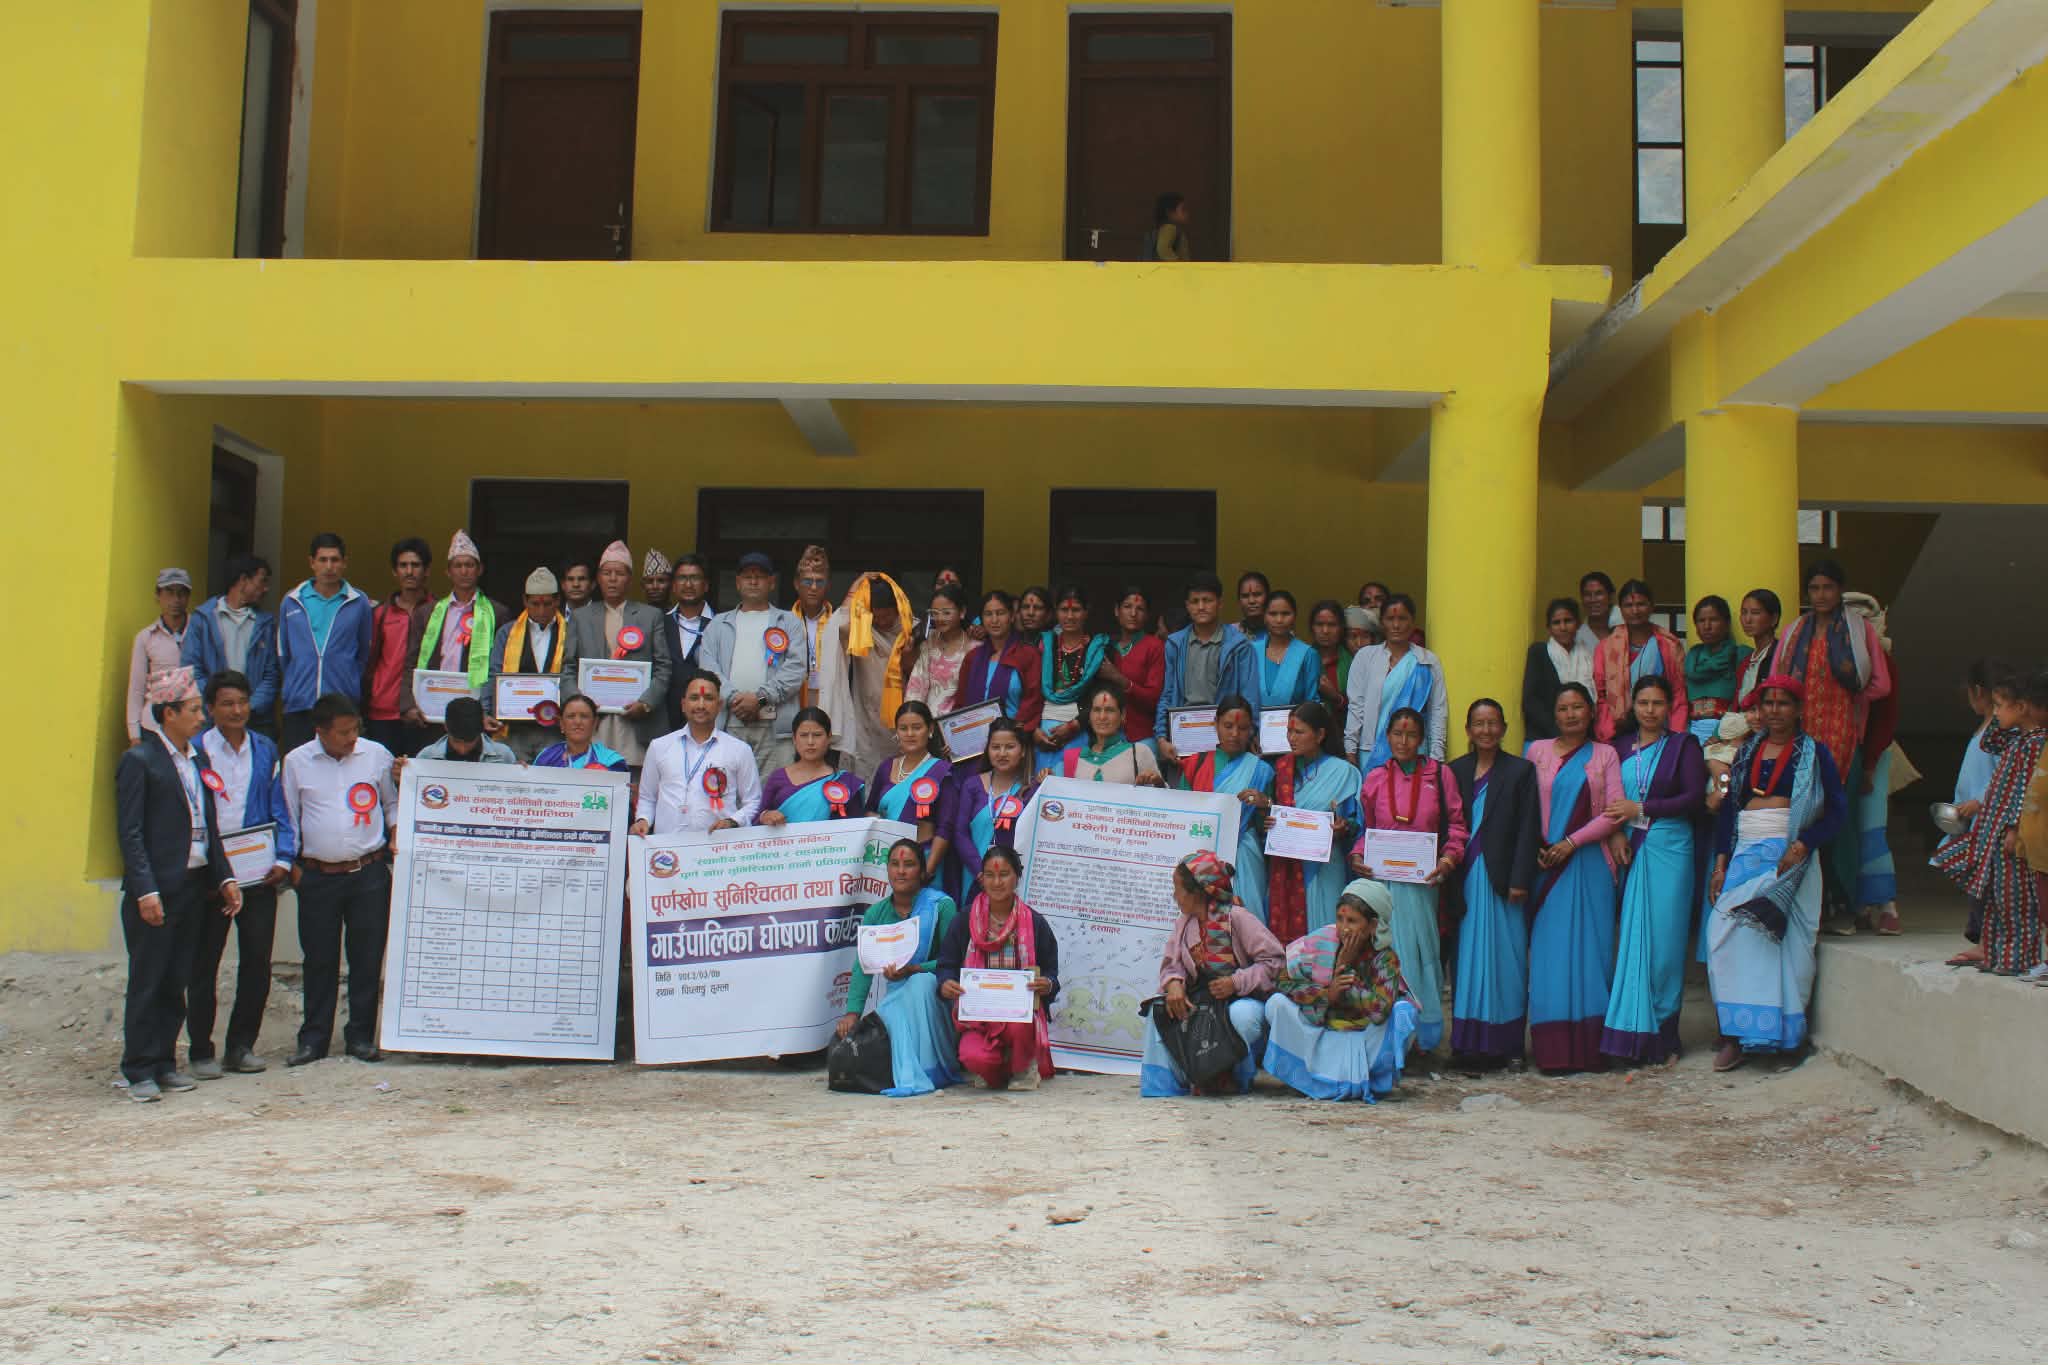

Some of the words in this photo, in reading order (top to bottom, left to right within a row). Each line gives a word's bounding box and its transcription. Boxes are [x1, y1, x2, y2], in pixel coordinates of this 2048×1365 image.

[651, 887, 709, 917] पूर्णखोप
[713, 881, 799, 911] सुनिश्चितता
[804, 880, 835, 899] तथा
[839, 872, 889, 898] दिगोपना
[651, 919, 755, 960] गाउँपालिका
[760, 915, 819, 950] घोषणा
[655, 971, 672, 982] मिति
[656, 987, 674, 998] स्थान
